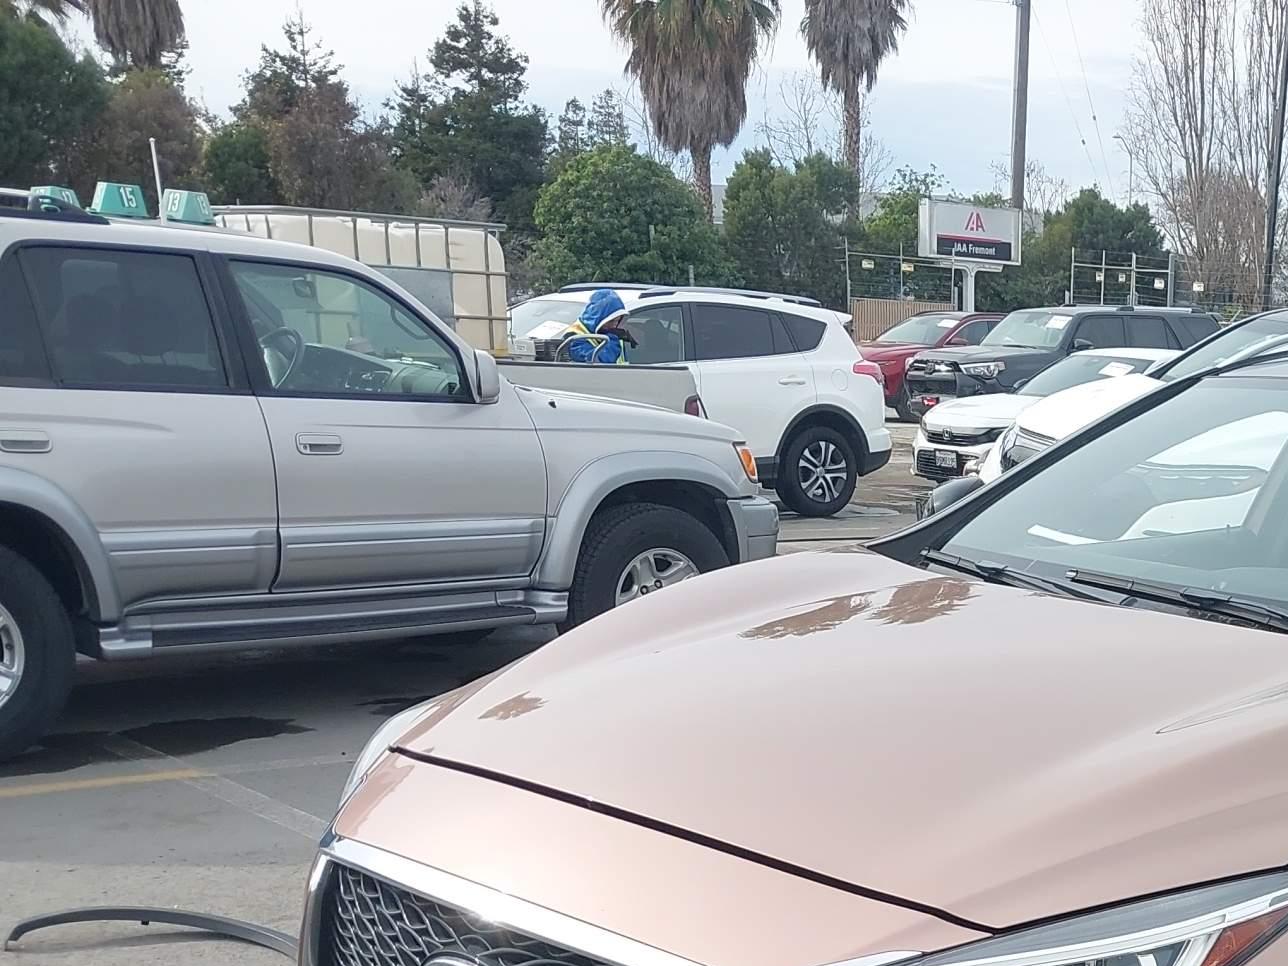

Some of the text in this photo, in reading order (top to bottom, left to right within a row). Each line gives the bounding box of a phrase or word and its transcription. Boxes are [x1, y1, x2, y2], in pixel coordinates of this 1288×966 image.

[120, 186, 137, 208] 15
[167, 191, 180, 212] 13
[968, 244, 996, 256] Fremont
